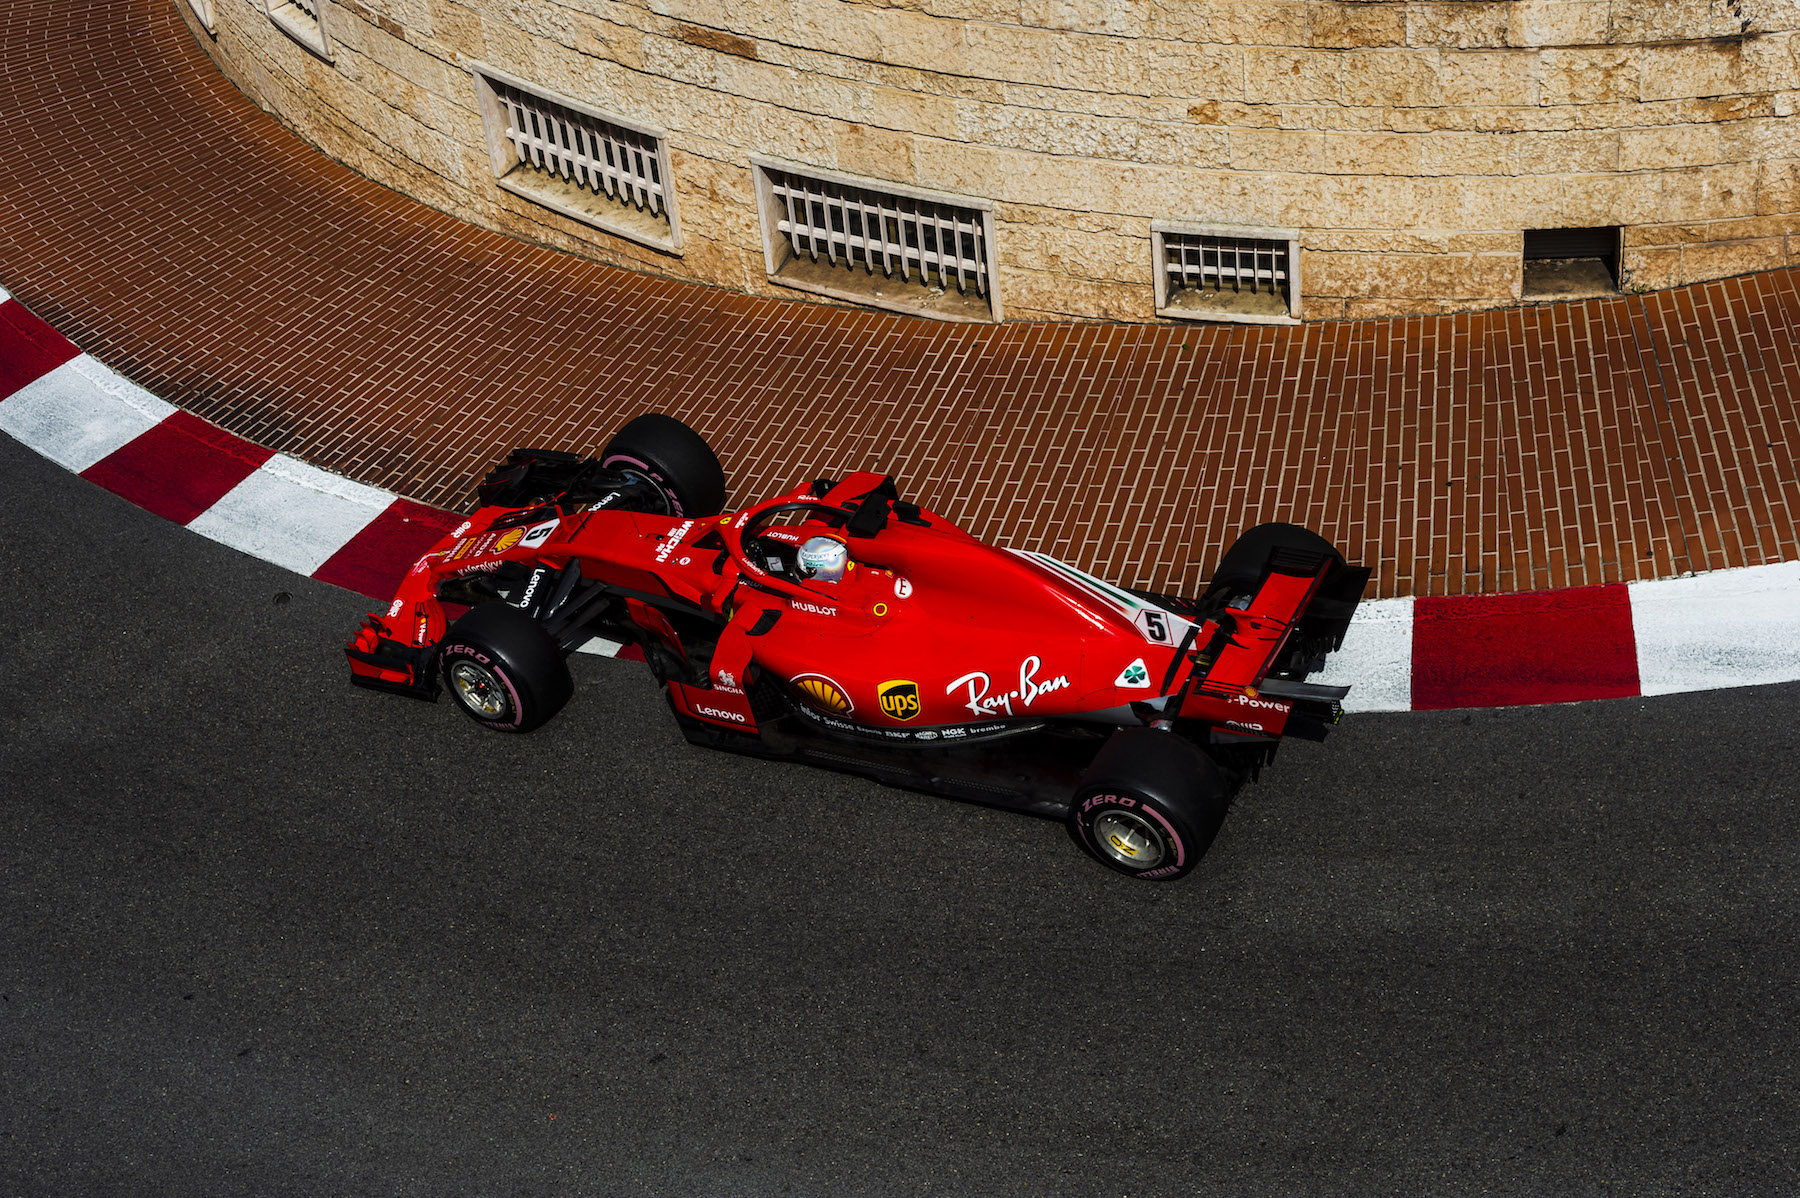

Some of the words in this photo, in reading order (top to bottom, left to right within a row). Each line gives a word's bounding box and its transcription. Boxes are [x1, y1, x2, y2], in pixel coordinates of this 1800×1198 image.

[525, 526, 554, 541] 5
[519, 568, 545, 608] Lenovo
[899, 578, 907, 596] E
[791, 600, 837, 617] HUBLOT
[1149, 610, 1167, 642] 5
[446, 644, 490, 664] ZERO
[696, 703, 745, 722] Lenovo
[881, 694, 919, 717] ups
[970, 724, 1006, 734] brembo
[1082, 794, 1136, 812] ZERO
